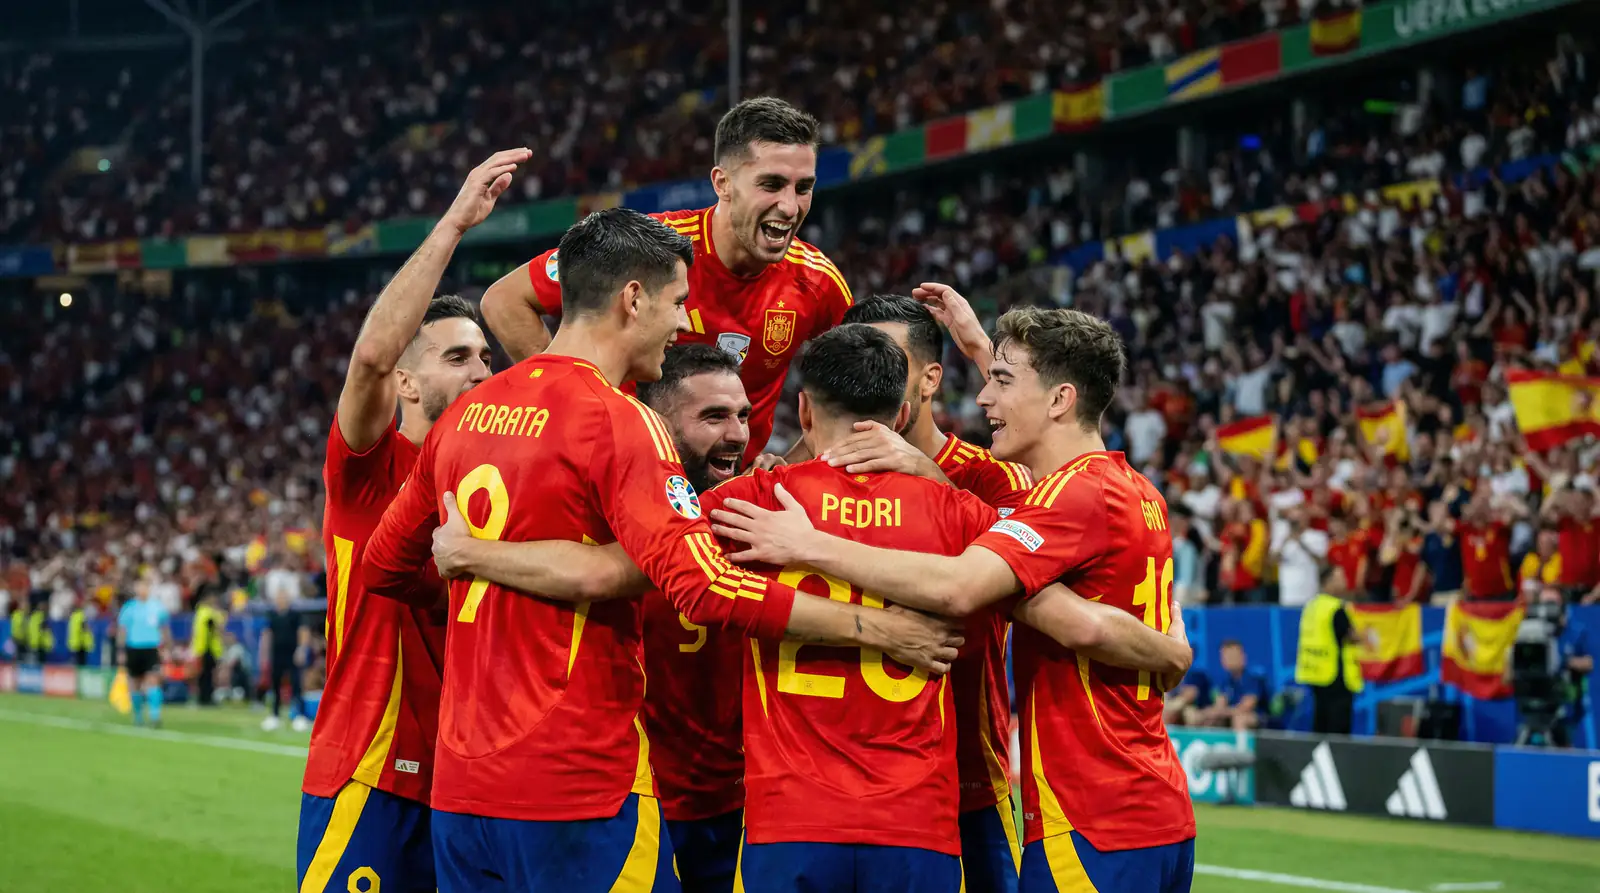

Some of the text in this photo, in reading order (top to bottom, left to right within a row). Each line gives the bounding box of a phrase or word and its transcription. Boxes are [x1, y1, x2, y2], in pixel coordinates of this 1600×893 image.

[457, 402, 550, 438] MORATA
[821, 492, 902, 528] PEDRI
[456, 463, 510, 623] 9
